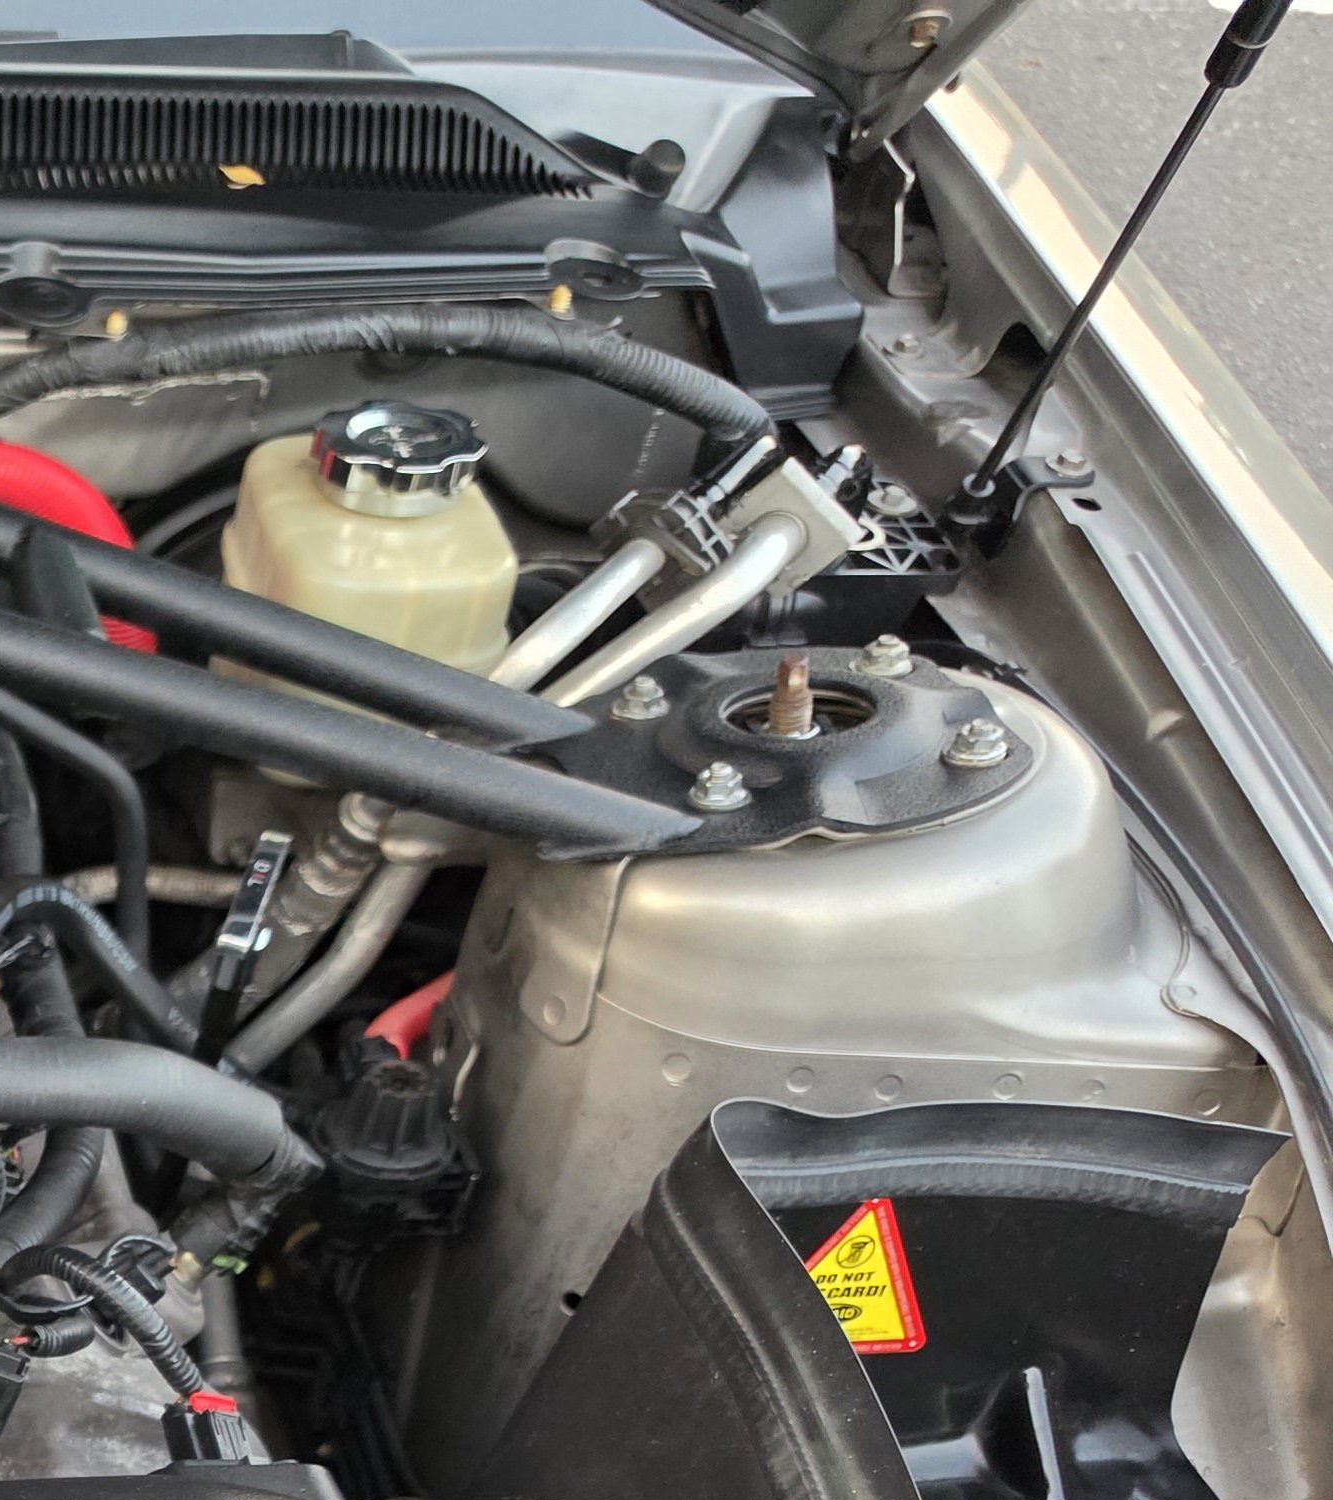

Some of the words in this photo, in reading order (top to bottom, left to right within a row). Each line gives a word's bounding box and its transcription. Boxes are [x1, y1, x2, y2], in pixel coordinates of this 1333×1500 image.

[815, 1273, 838, 1285] DO
[841, 1271, 876, 1283] NOT
[821, 1285, 887, 1299] CARD!
